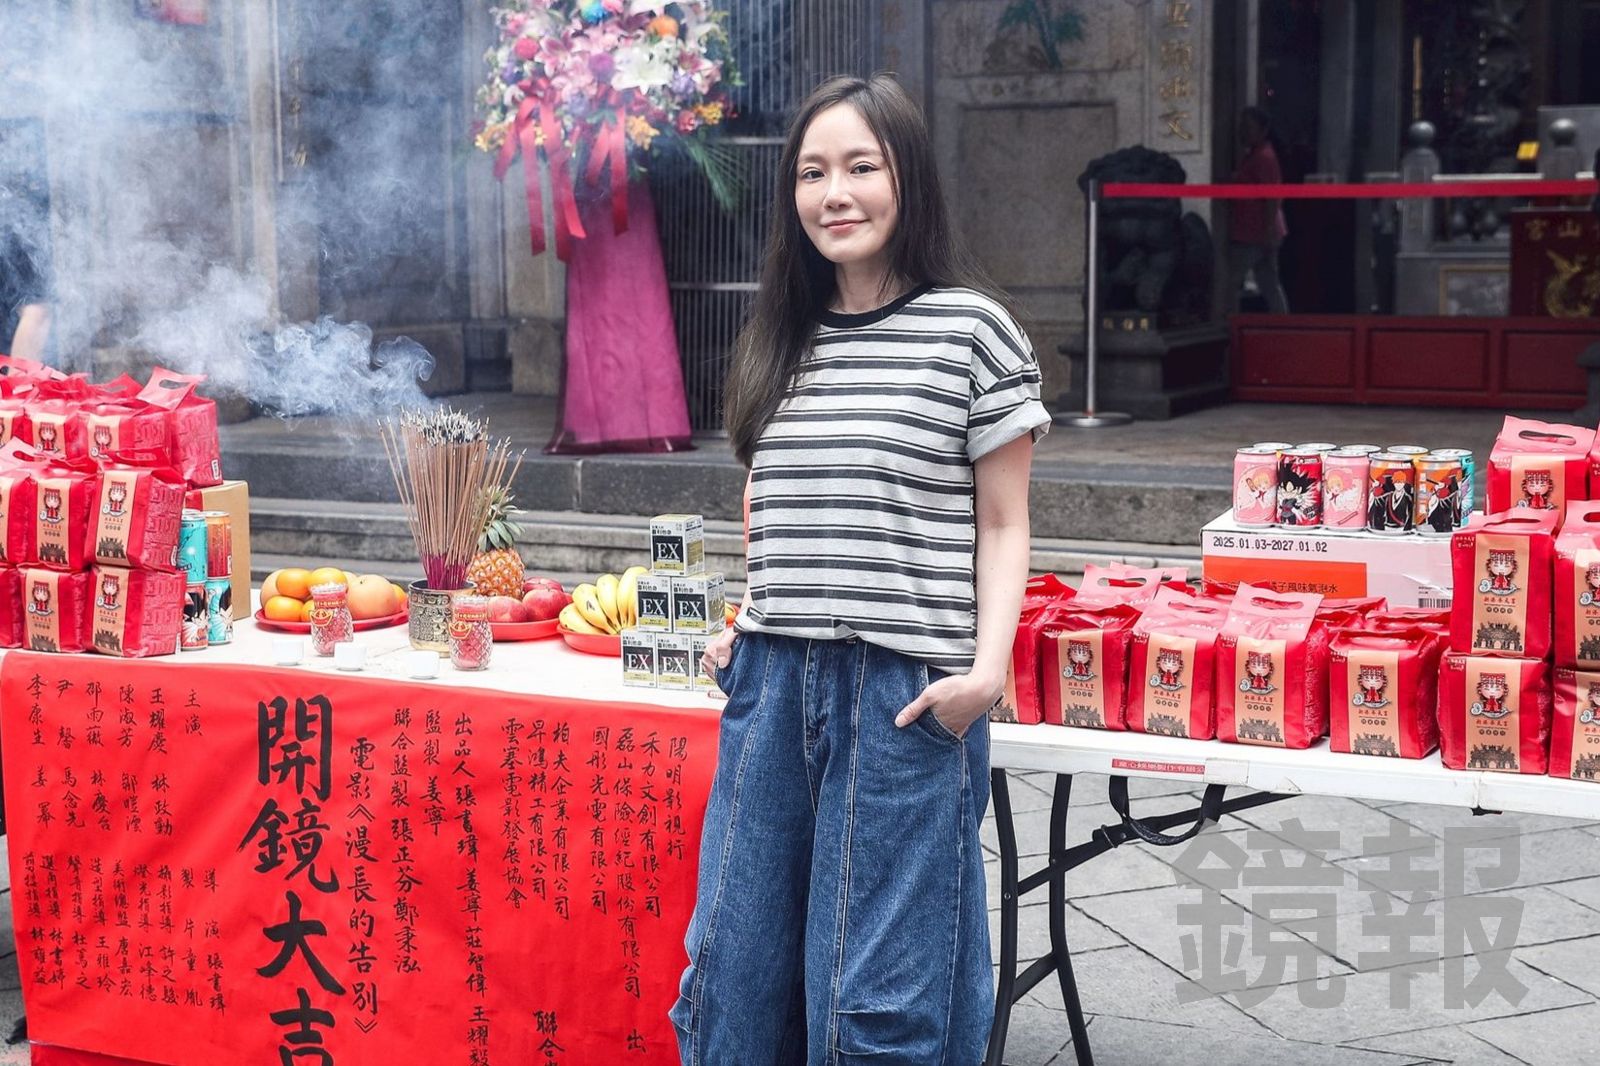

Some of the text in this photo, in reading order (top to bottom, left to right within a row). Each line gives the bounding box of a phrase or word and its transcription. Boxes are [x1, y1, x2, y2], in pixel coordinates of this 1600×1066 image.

[657, 542, 680, 560] EX
[1213, 536, 1328, 553] 2025.01.03-2027.01.02
[641, 598, 665, 616] EX
[677, 601, 702, 618] EX
[626, 653, 650, 671] EX
[661, 656, 686, 674] EX
[27, 674, 45, 744] 李康生
[87, 682, 103, 746] 邵雨薇
[119, 685, 136, 747] 陳淑芳
[149, 688, 167, 754] 王耀慶
[186, 690, 201, 735] 主演
[424, 710, 441, 765] 監製
[391, 708, 414, 808] 聯合監製
[452, 713, 475, 778] 出品人
[63, 767, 85, 828] 馬念先
[238, 694, 346, 1066] 開鏡大吉
[346, 738, 378, 1034] 電影《漫長的告別》
